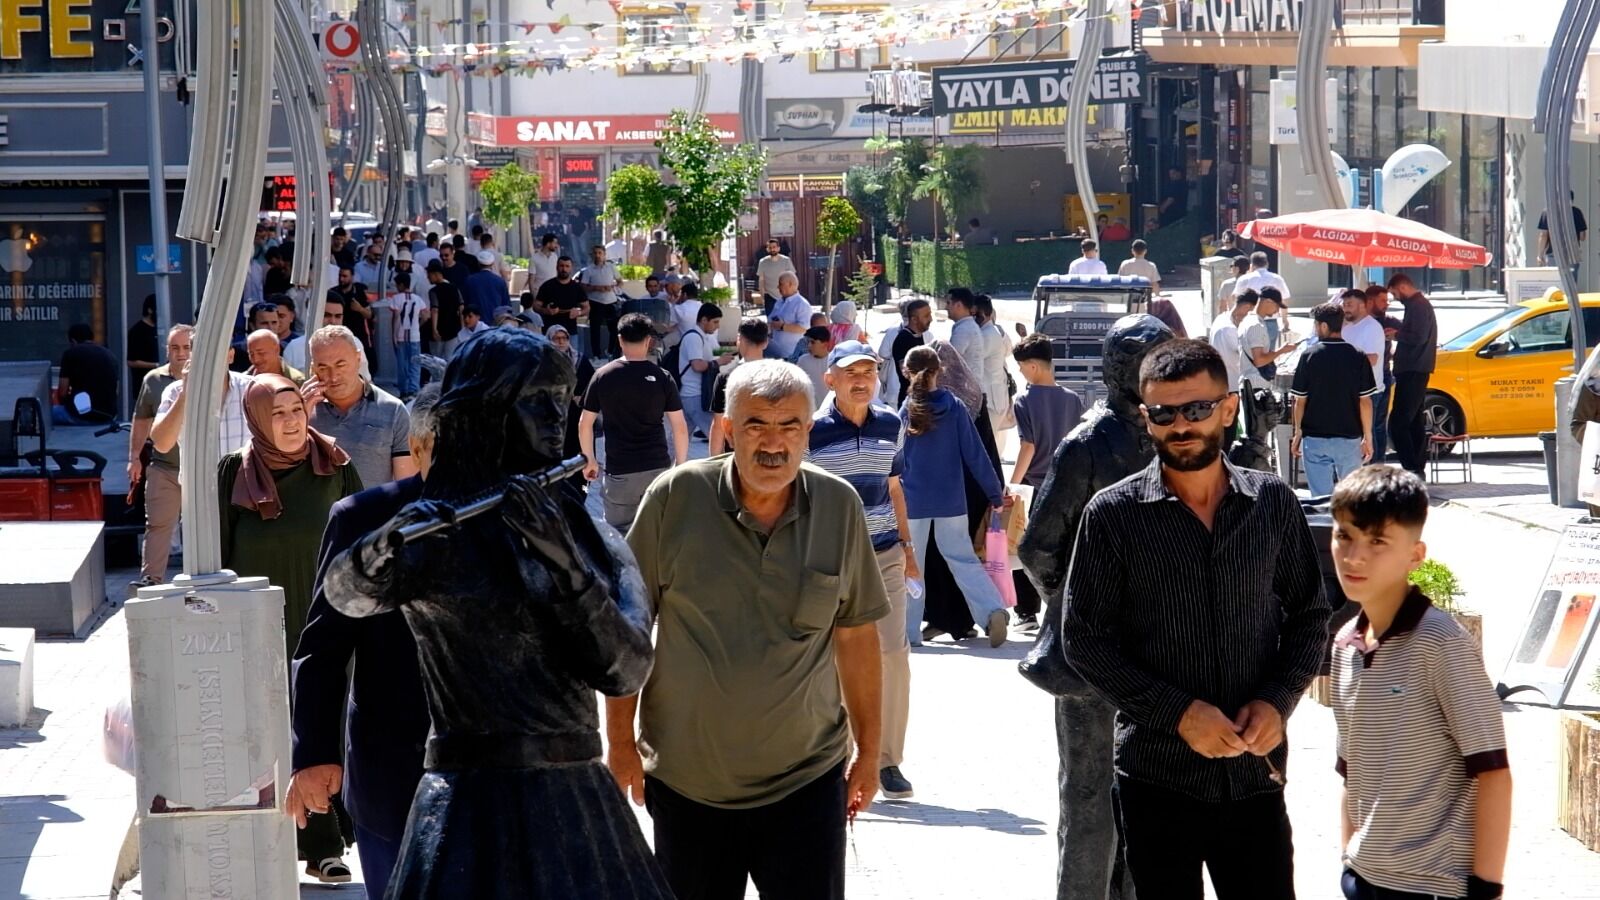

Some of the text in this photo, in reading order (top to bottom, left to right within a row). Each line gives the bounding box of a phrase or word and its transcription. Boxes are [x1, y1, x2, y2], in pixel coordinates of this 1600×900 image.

[940, 79, 1030, 109] YAYLA
[1010, 104, 1098, 126] MARKT
[517, 121, 610, 141] SANAT
[1278, 126, 1296, 135] Türk
[16, 307, 59, 321] SATILIR
[180, 631, 234, 656] 2021
